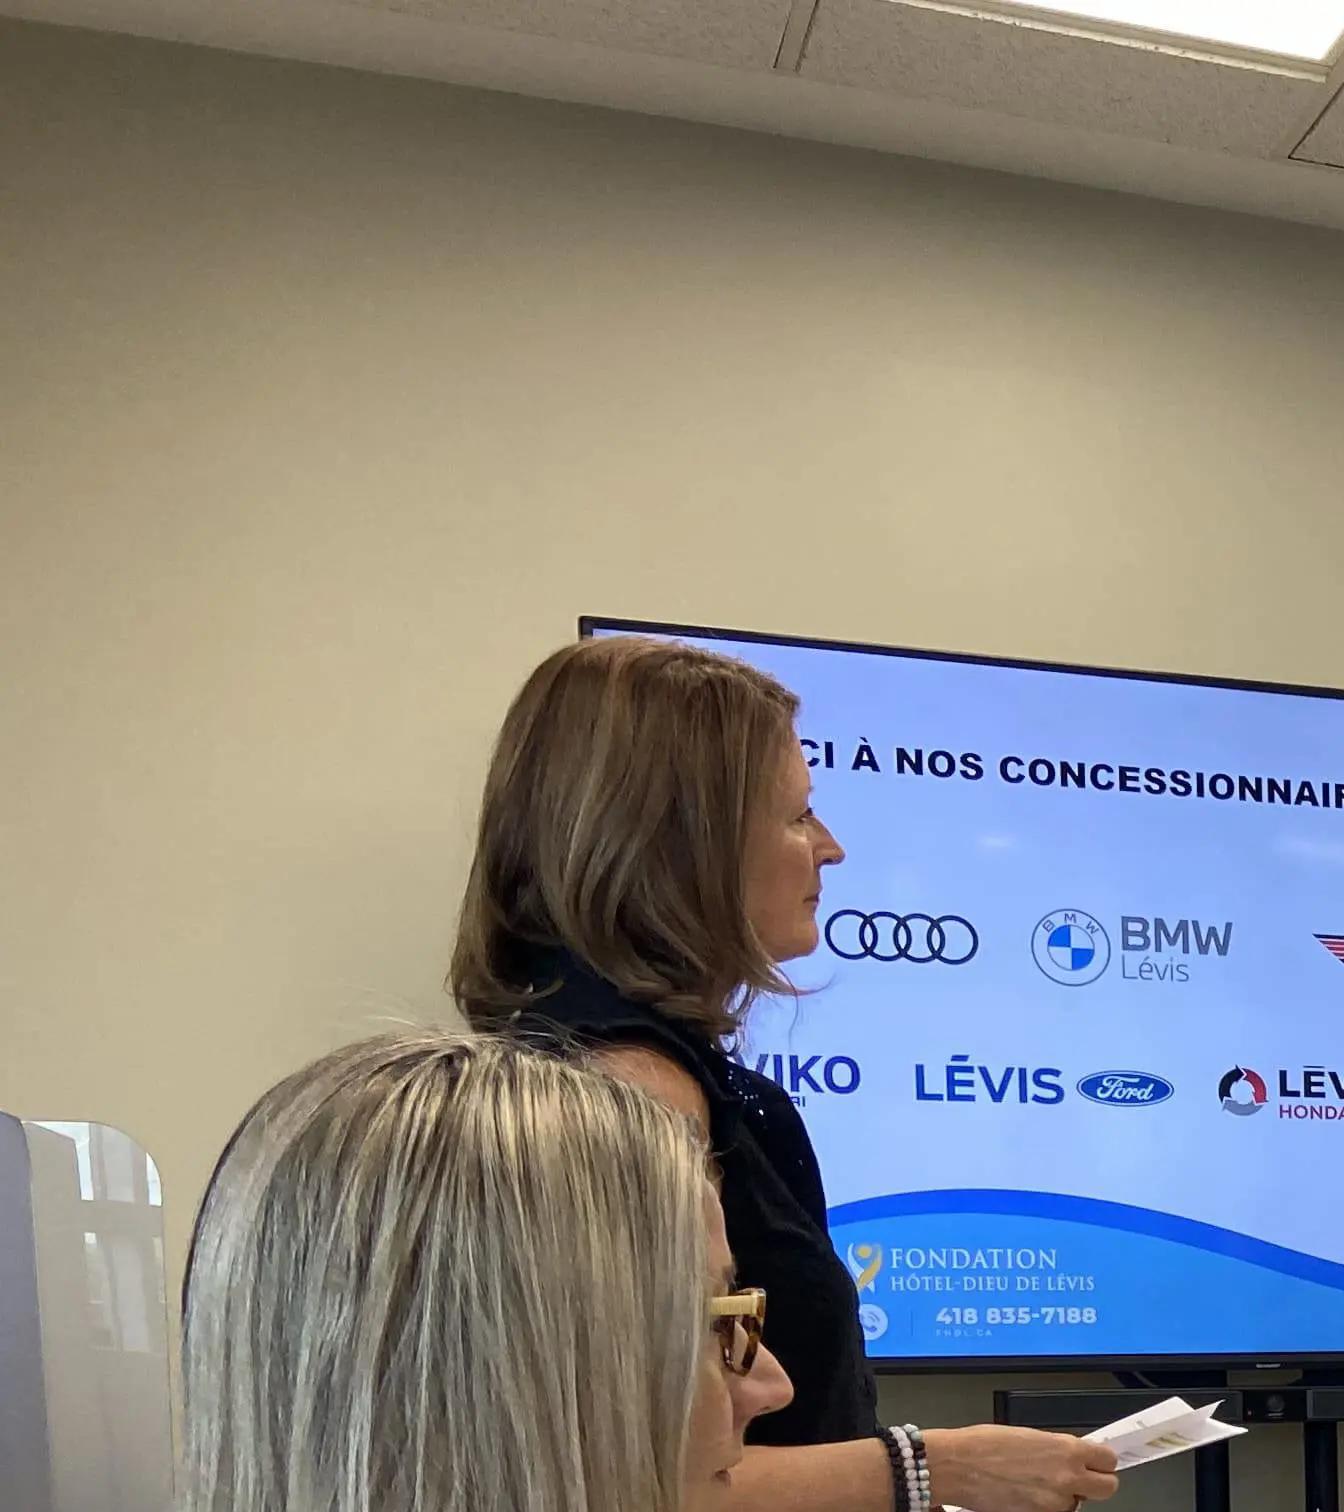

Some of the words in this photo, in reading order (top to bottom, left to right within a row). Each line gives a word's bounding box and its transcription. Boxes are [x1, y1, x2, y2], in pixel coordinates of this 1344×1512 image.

[851, 737, 880, 773] À
[896, 747, 984, 780] NOS
[1121, 915, 1233, 956] BMW
[1122, 954, 1190, 982] Lévis
[738, 1053, 861, 1095] VIKO
[1096, 1076, 1154, 1102] Ford
[890, 1248, 1057, 1269] FONDATION
[891, 1273, 1008, 1292] HÔTEL-DIEU
[1016, 1276, 1042, 1291] DE
[1048, 1273, 1094, 1291] LÉVIS
[935, 1307, 978, 1325] 418
[986, 1307, 1097, 1325] 835-7188
